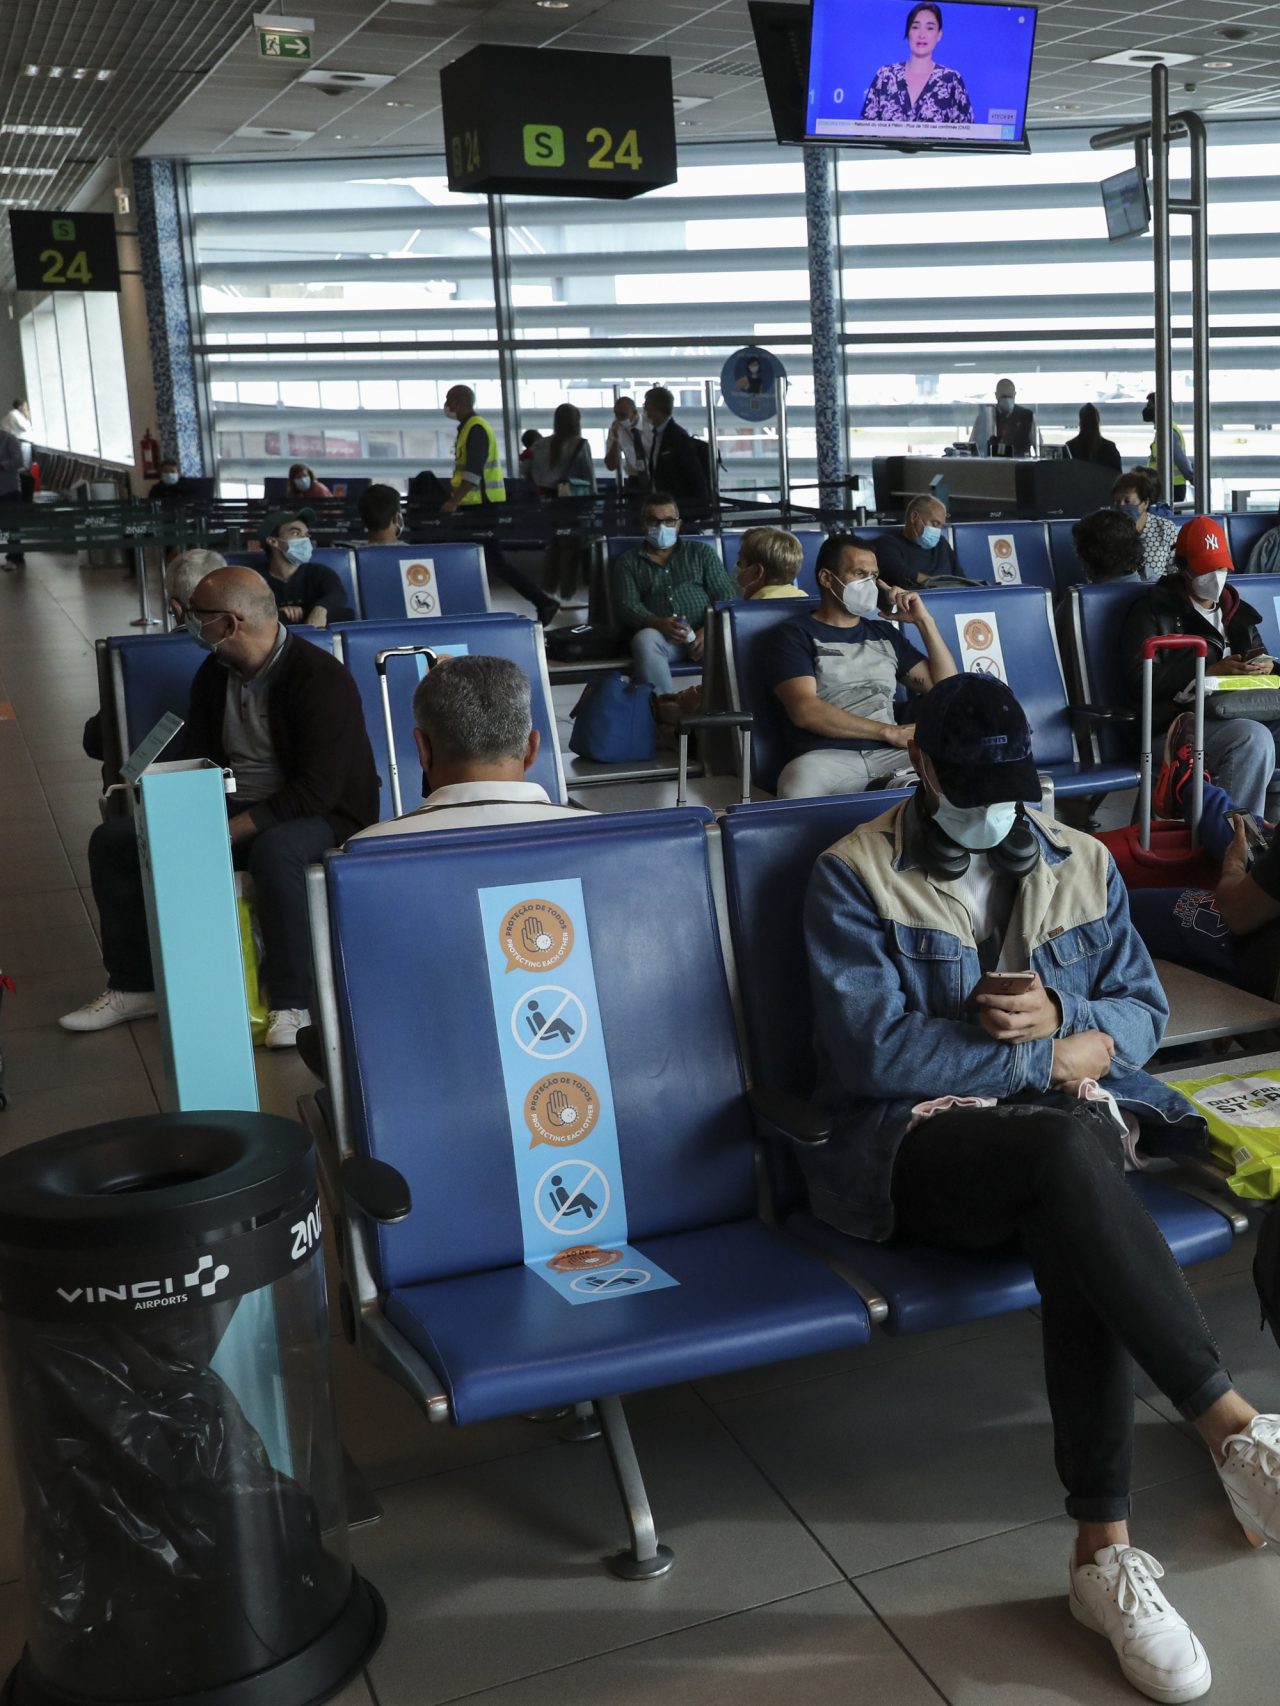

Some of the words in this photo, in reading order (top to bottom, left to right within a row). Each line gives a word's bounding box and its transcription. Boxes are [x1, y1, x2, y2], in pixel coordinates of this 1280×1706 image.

[535, 132, 554, 159] S
[586, 127, 643, 170] 24
[58, 223, 70, 236] S
[40, 249, 92, 284] 24
[1204, 533, 1219, 550] NY
[506, 904, 534, 936] PROTEÇÃO
[547, 906, 567, 930] TODOS
[506, 938, 542, 968] PROTECTING
[542, 954, 560, 967] EACH
[558, 932, 569, 956] OTHER
[530, 1077, 558, 1111] PROTEÇÃO
[572, 1079, 592, 1102] TODOS
[1207, 1095, 1248, 1106] DUTY
[531, 1113, 566, 1142] PROTECTING
[566, 1128, 585, 1141] EACH
[582, 1104, 594, 1129] OTHER
[56, 1277, 174, 1303] VINCI
[134, 1294, 188, 1311] AIRPORTS
